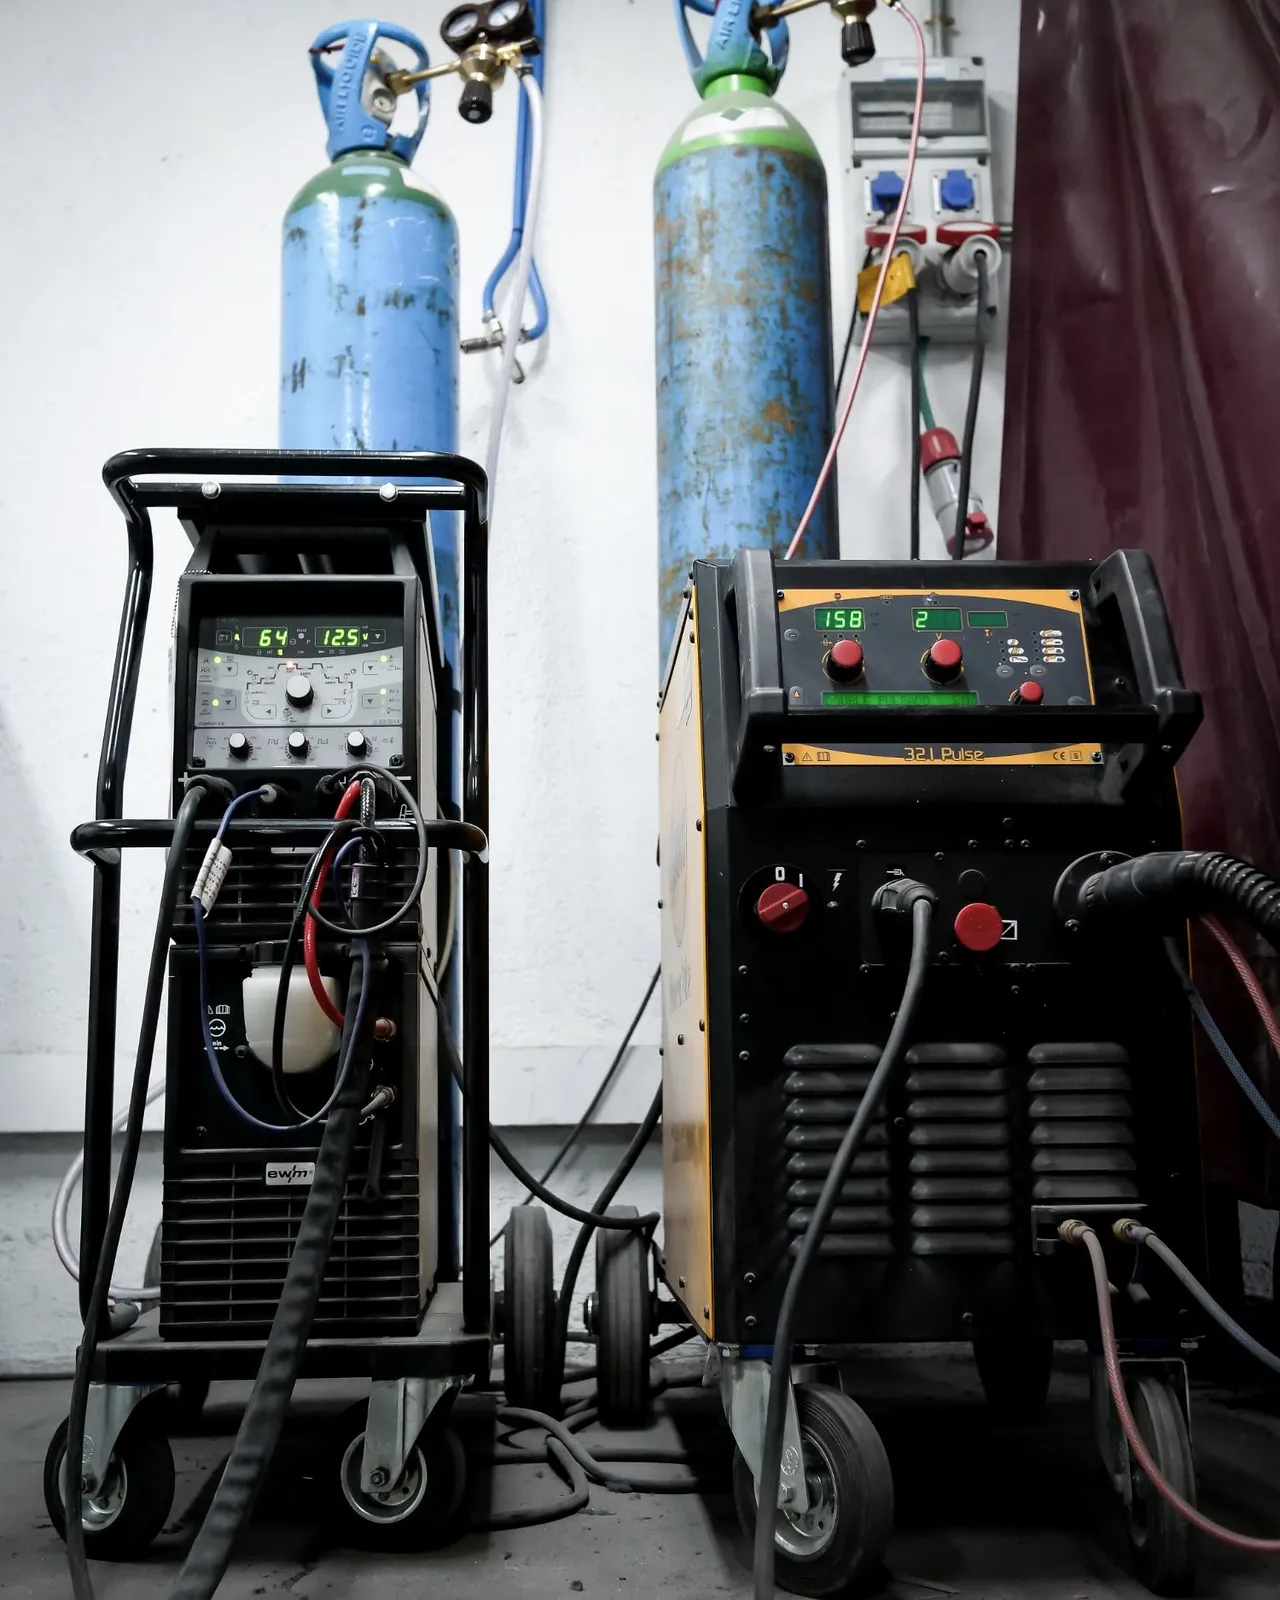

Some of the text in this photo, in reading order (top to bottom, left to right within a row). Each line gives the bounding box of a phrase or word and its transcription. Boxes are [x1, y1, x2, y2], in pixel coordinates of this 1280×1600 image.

[825, 610, 862, 629] 158
[915, 611, 928, 628] 2
[259, 629, 288, 647] 64
[323, 628, 359, 646] 12.5
[903, 747, 985, 762] 321 Pulse
[267, 1164, 308, 1184] ewm
